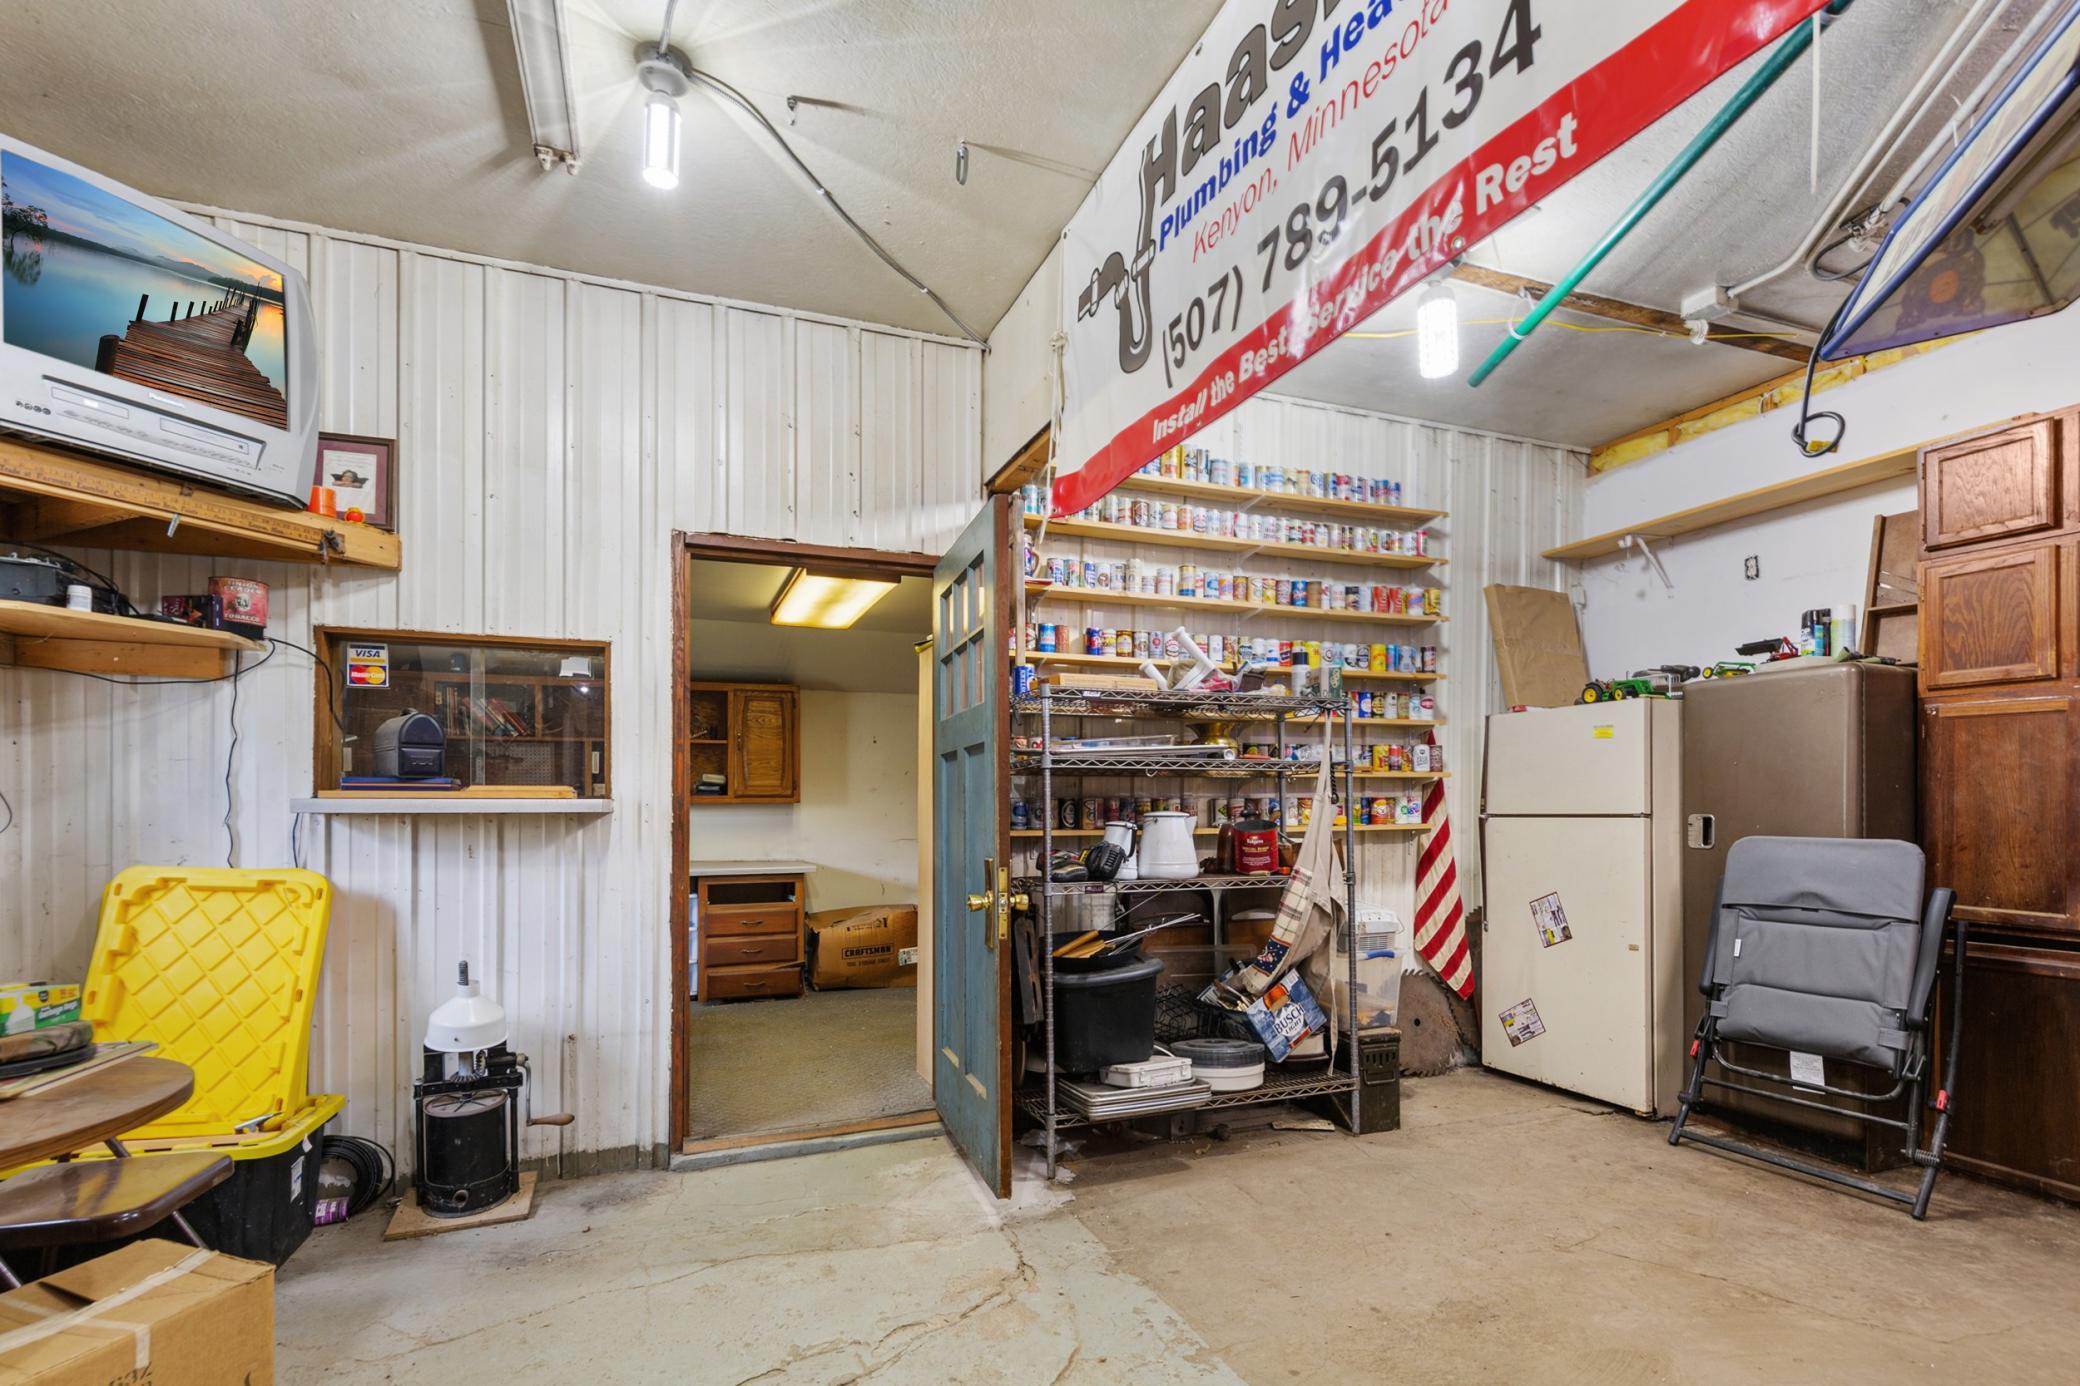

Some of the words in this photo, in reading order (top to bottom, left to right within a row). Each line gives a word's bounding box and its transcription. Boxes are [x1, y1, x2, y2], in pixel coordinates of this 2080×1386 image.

[1142, 0, 1341, 207] Haas
[1159, 101, 1277, 252] Plumbing
[1286, 70, 1310, 119] &
[1319, 0, 1402, 84] Hea
[1192, 168, 1278, 263] Kenyon,
[1288, 0, 1448, 171] Minnesota
[1162, 265, 1243, 388] (507)
[1257, 0, 1541, 293] 789-5134
[1153, 391, 1207, 443] Install
[1210, 371, 1235, 406] the
[1302, 248, 1398, 337] Service
[1407, 190, 1464, 260] the
[1475, 112, 1578, 216] Rest
[224, 613, 260, 621] TOBACCO
[355, 649, 381, 658] VISA
[844, 945, 891, 957] CRAFTSMAN
[1273, 1005, 1304, 1034] BUSCH
[1284, 1018, 1302, 1034] LIGHT
